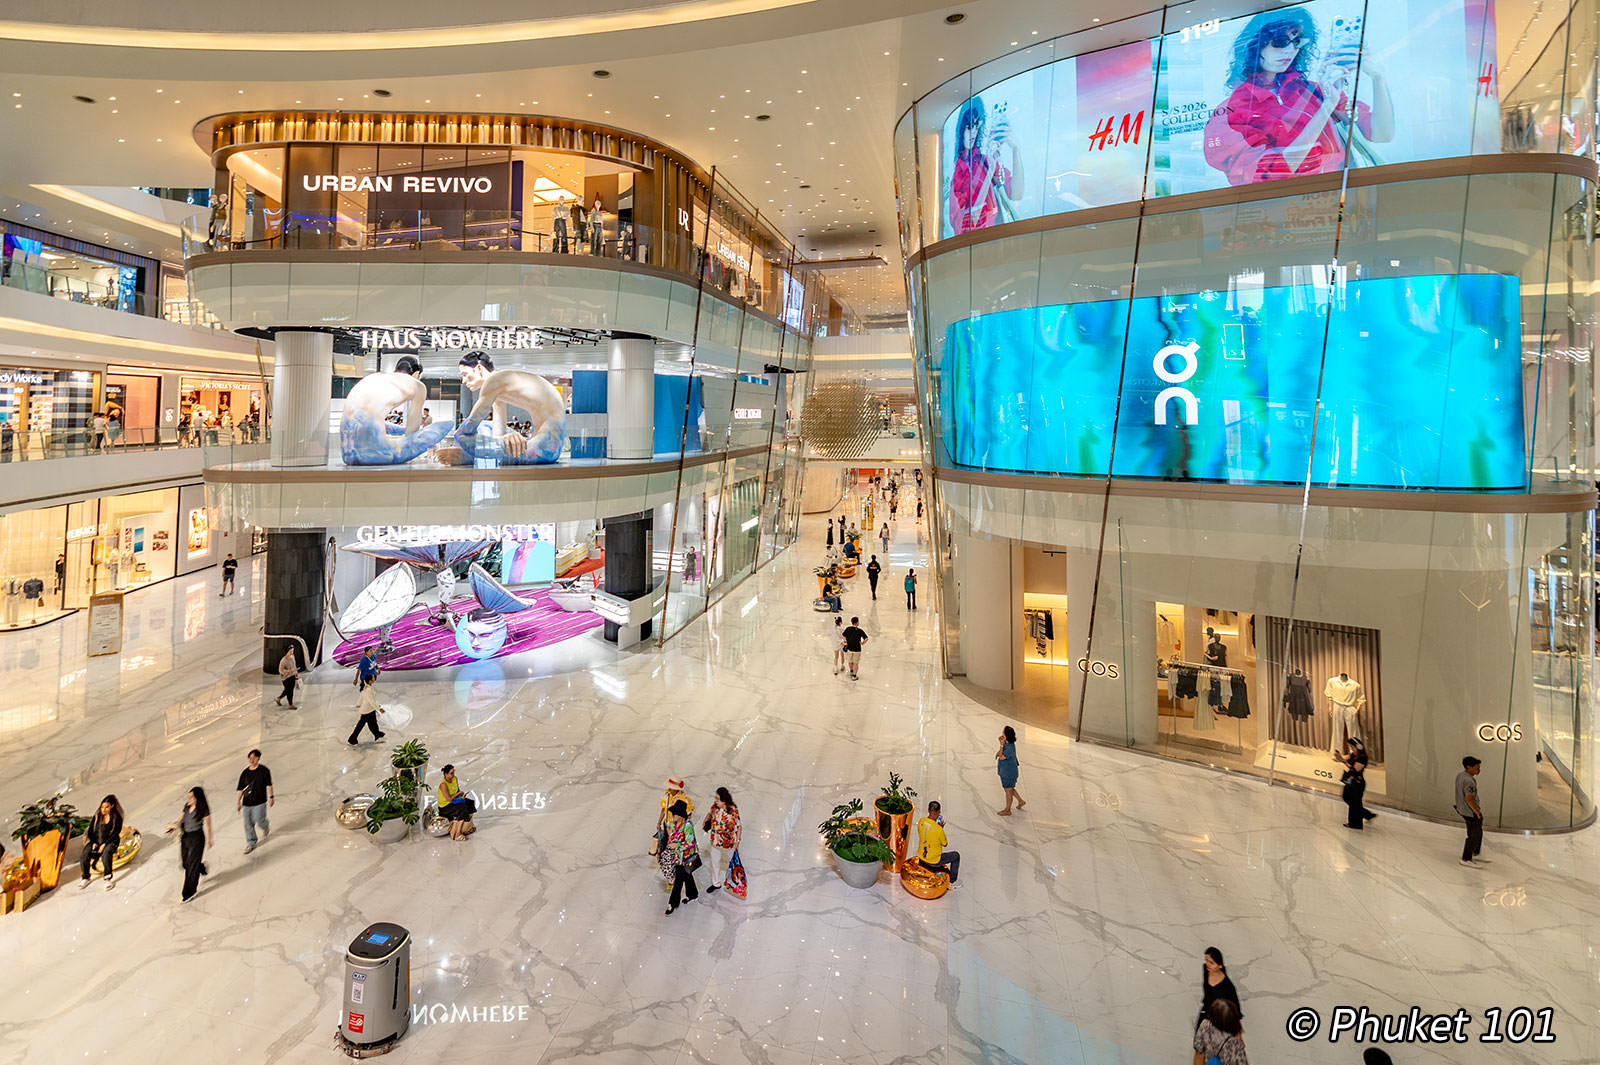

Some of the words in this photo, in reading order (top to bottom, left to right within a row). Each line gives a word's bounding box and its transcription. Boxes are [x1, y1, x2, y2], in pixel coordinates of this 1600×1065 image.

[1162, 106, 1235, 126] COLLECTION
[1181, 101, 1207, 113] 2026
[1088, 110, 1144, 152] H&M
[302, 174, 393, 193] URBAN
[403, 176, 493, 194] REVIVO
[360, 330, 422, 350] HAUS
[430, 330, 544, 350] NOWHERE
[1077, 658, 1119, 679] COS
[1476, 722, 1523, 743] COS
[1313, 768, 1333, 779] COS
